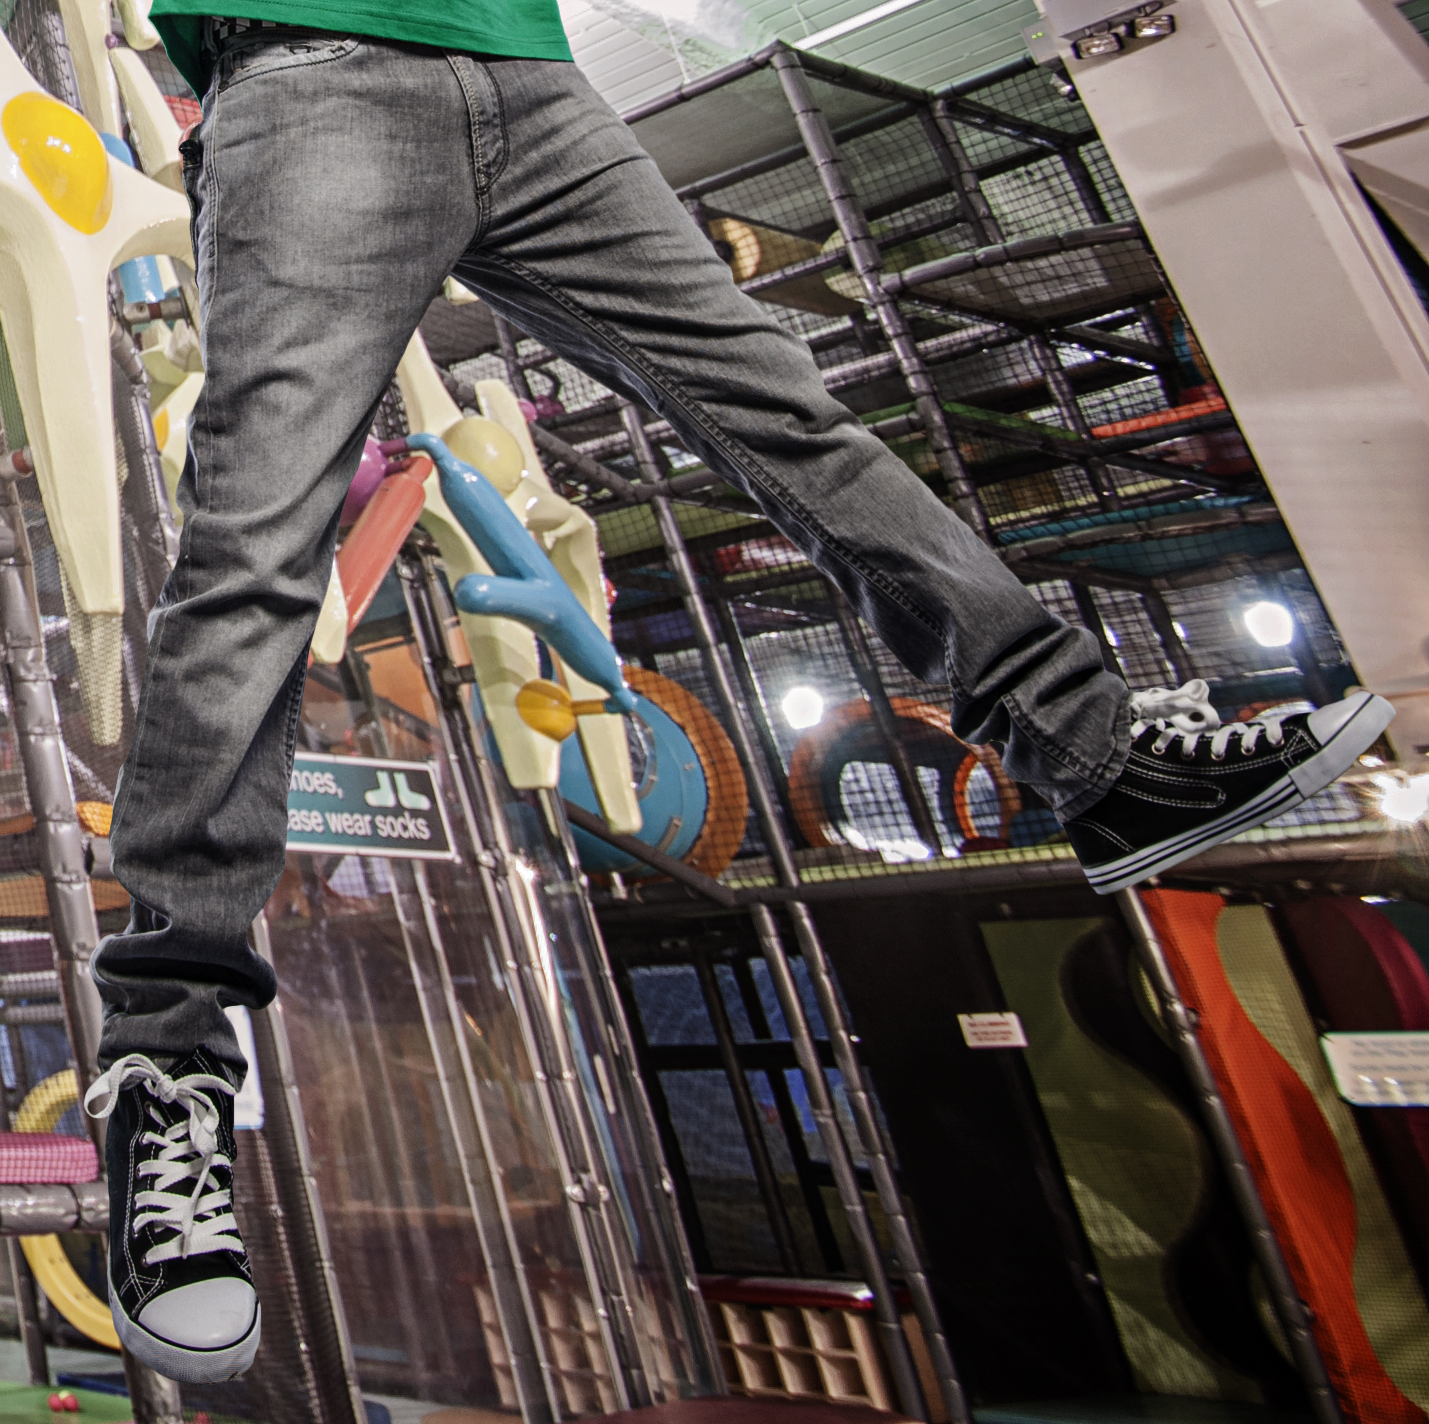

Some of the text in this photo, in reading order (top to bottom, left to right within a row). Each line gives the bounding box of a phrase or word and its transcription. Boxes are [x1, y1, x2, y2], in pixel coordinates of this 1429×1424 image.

[287, 808, 431, 841] ase wear socks
